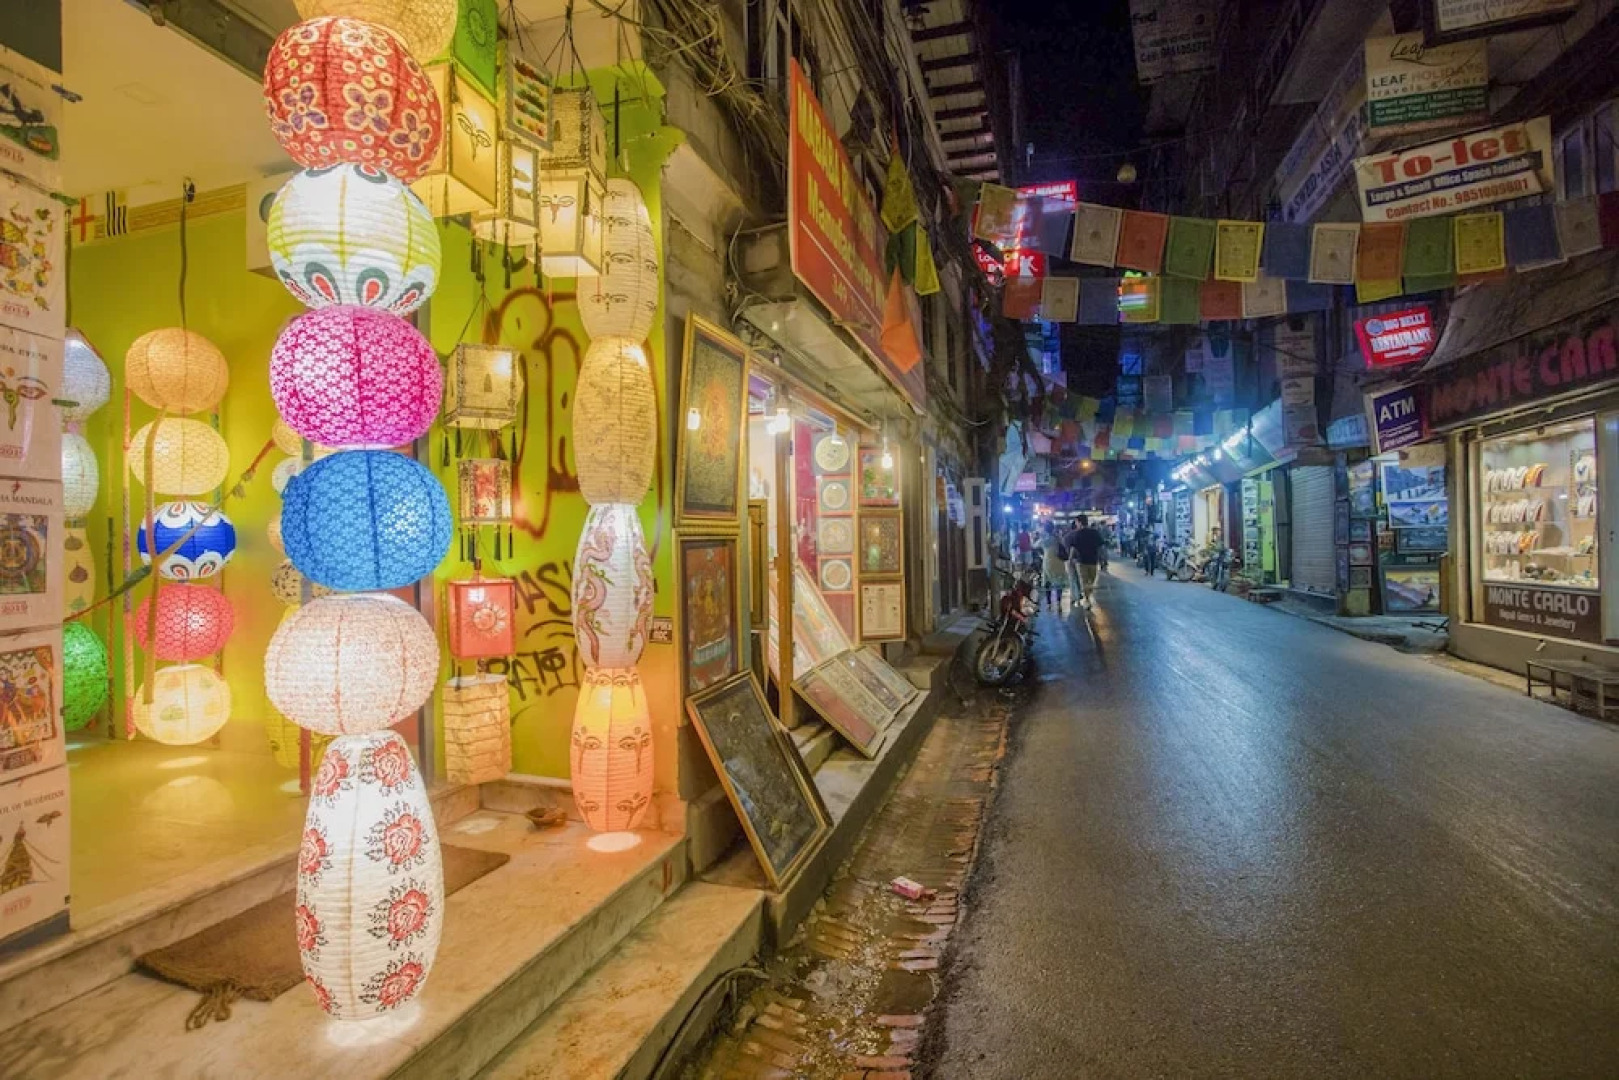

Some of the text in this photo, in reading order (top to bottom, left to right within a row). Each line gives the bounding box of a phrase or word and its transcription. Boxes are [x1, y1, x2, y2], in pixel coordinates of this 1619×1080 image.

[1372, 73, 1407, 88] LEAF
[1373, 130, 1525, 184] To-let
[1386, 200, 1430, 219] Contact
[1370, 326, 1431, 353] RESTAURANT
[1431, 356, 1533, 420] MONTE
[1380, 396, 1415, 423] ATM
[13, 496, 53, 506] MANDALA
[1488, 586, 1590, 616] MONTE CARLO
